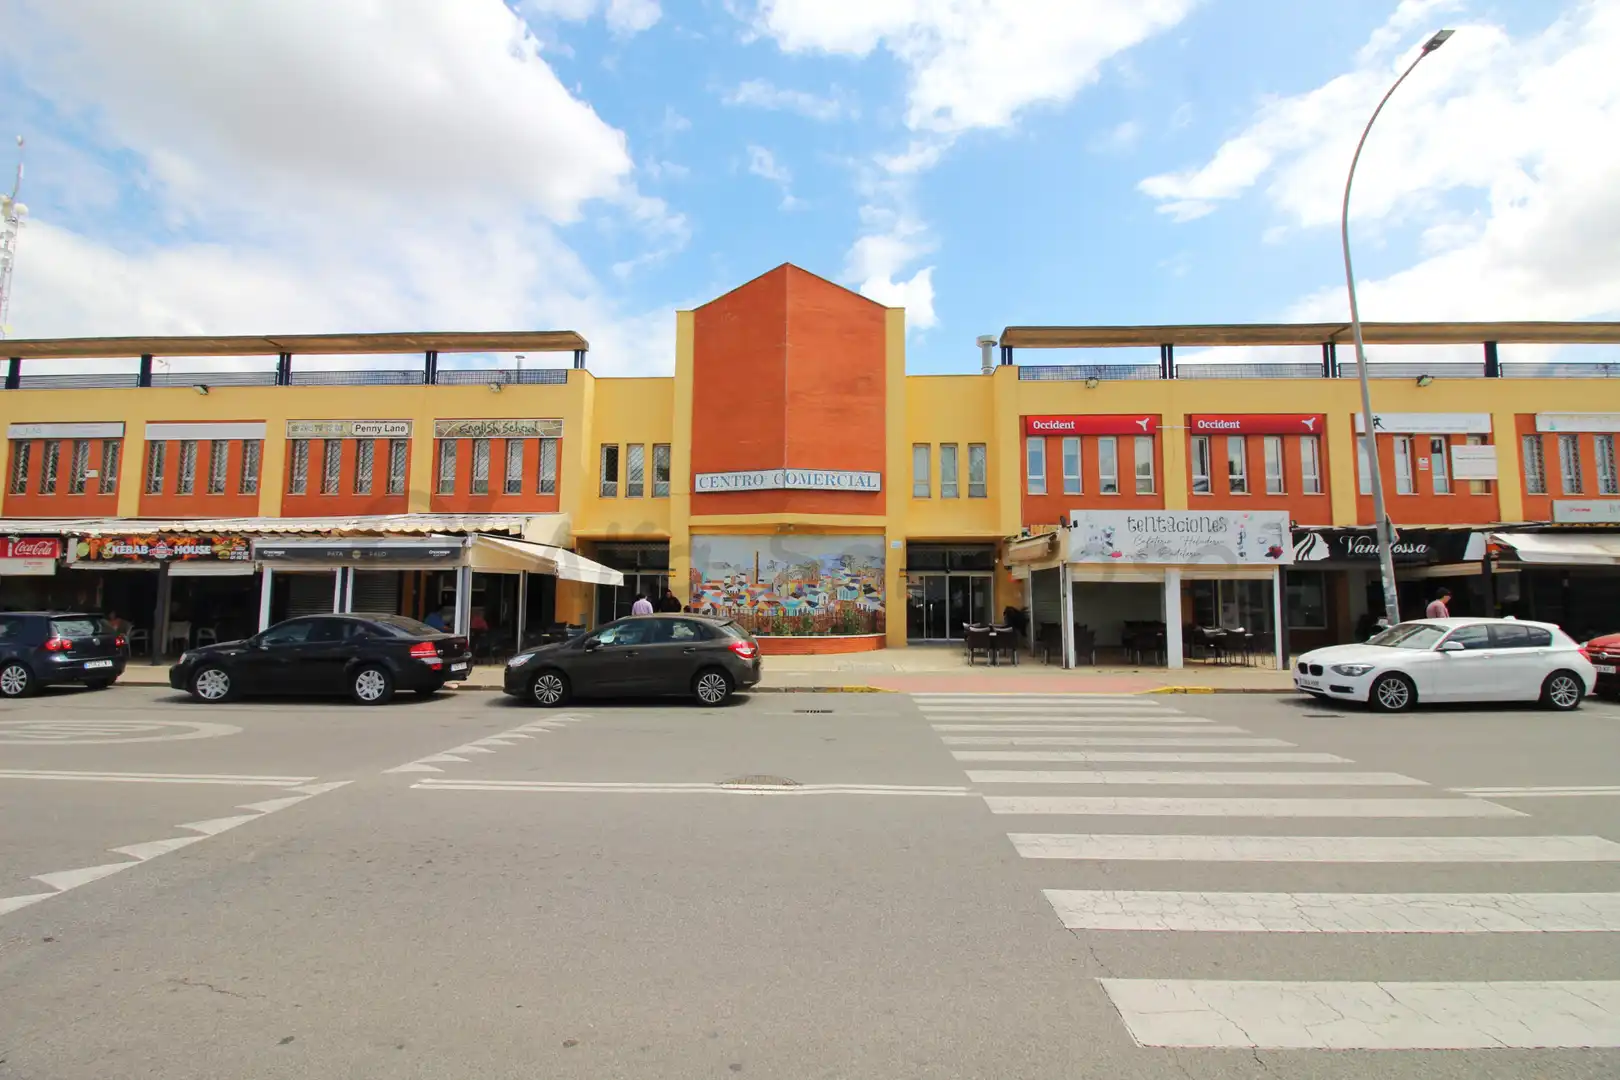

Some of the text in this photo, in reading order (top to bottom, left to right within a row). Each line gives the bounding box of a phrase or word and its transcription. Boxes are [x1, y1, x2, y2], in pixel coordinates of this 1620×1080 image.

[355, 423, 382, 434] Penny
[384, 424, 406, 432] Lane
[460, 420, 500, 436] English
[1033, 420, 1076, 430] Occident
[1197, 420, 1241, 429] Occident
[699, 471, 877, 489] CENTRO COMERCIAL
[1127, 516, 1228, 533] tentaciones
[174, 544, 212, 555] HOUSE
